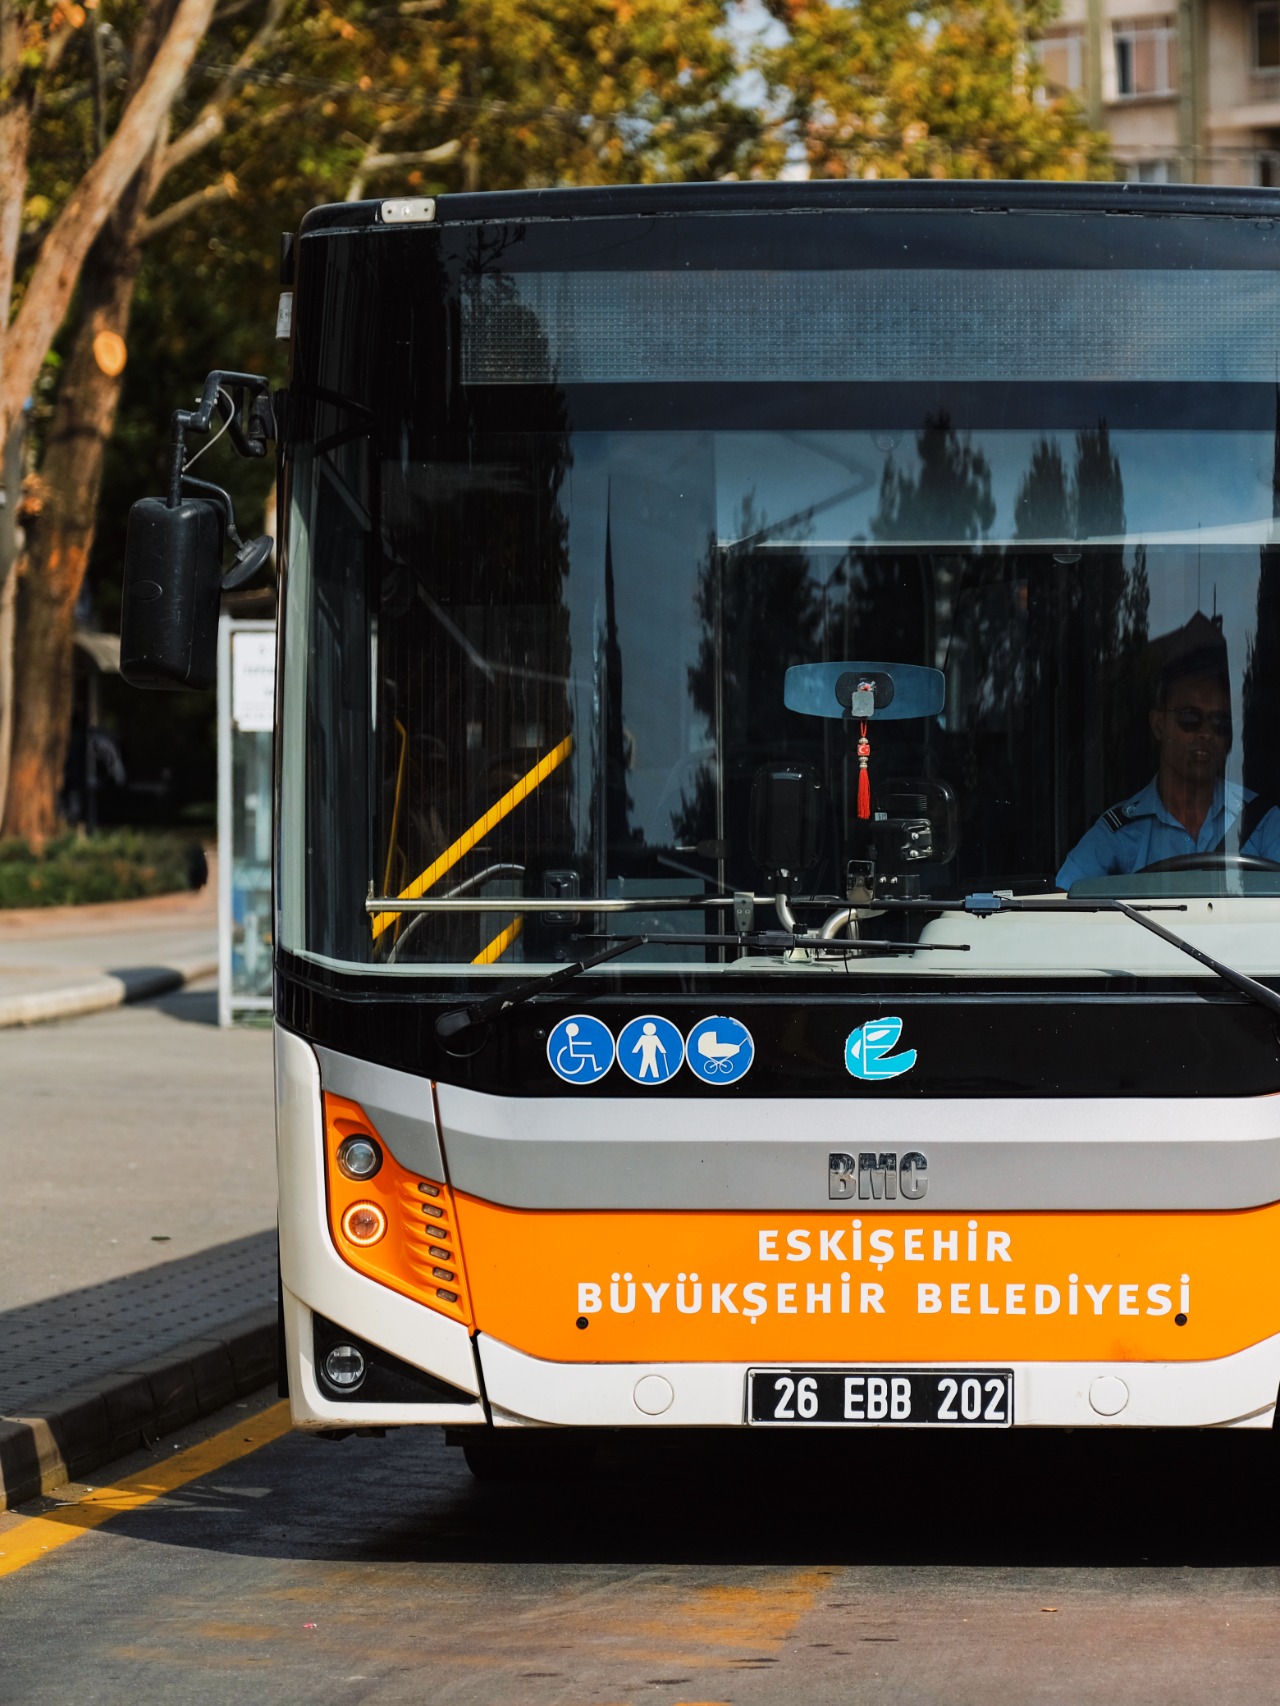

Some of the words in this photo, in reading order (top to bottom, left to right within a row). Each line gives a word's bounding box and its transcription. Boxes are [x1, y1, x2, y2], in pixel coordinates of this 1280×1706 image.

[828, 1151, 929, 1200] BMC
[758, 1219, 1013, 1272] ESKİŞEHİR
[577, 1271, 886, 1325] BÜYÜKŞEHİR
[917, 1273, 1192, 1316] BELEDİYESİ
[774, 1377, 819, 1420] 26
[844, 1377, 912, 1420] EBB
[937, 1378, 1006, 1421] 202
